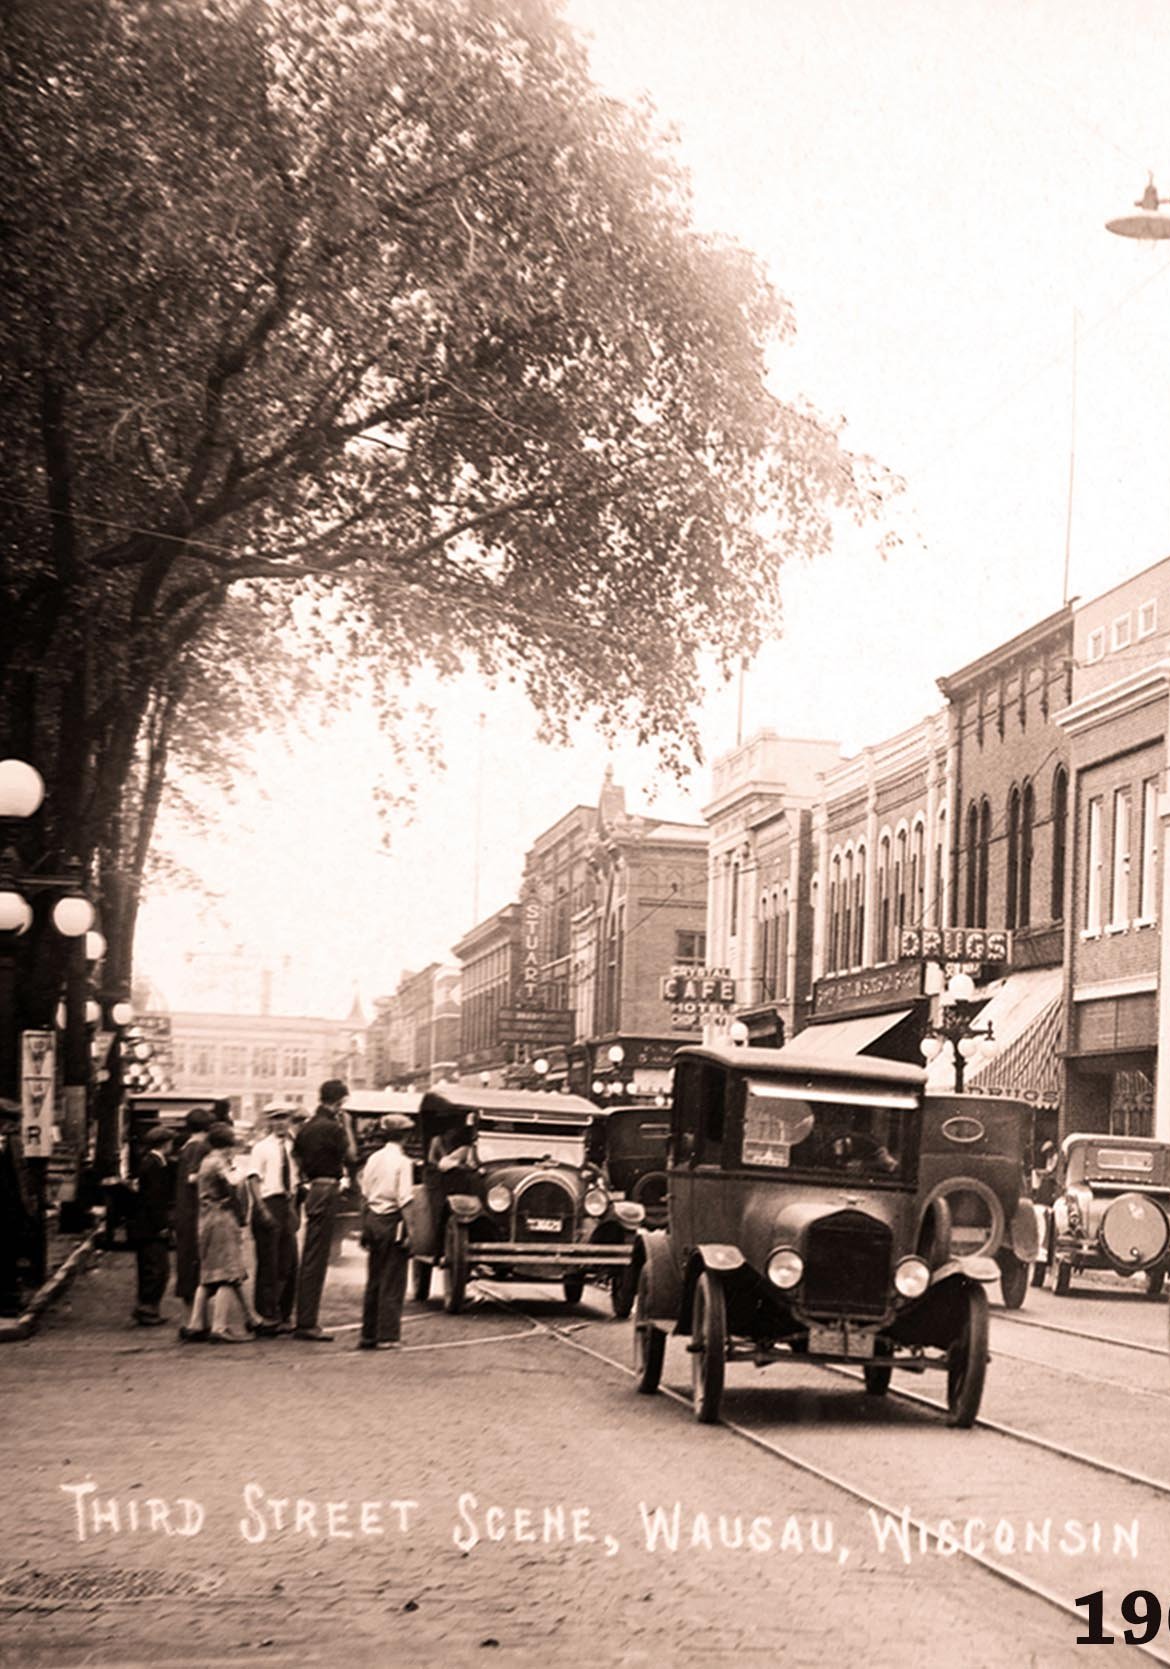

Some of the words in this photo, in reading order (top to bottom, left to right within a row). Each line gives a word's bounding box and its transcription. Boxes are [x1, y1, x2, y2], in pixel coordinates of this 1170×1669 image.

[523, 904, 540, 999] STUART
[901, 929, 1006, 961] DRUGS
[664, 979, 734, 1000] CAFE
